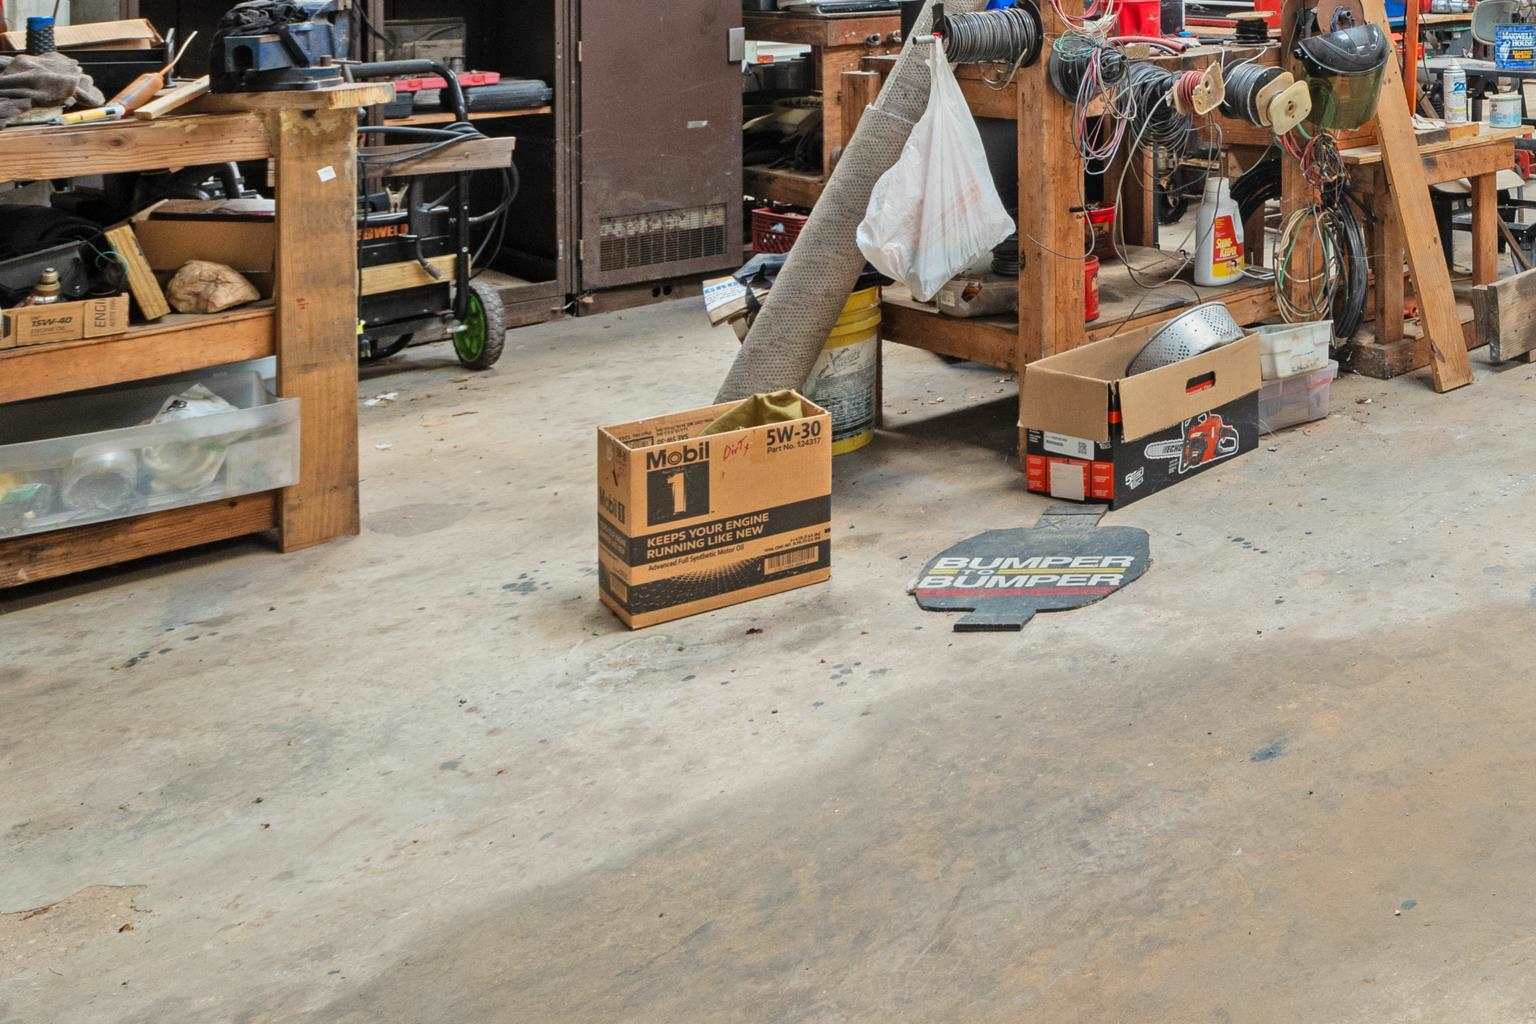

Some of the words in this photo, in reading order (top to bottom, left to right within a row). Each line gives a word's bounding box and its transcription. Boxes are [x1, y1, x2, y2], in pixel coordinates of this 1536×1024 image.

[766, 420, 821, 446] 5W-30
[646, 440, 710, 471] Mobil
[767, 445, 782, 454] Part
[783, 443, 795, 451] No.
[667, 472, 687, 516] 1
[646, 539, 705, 559] RUNNING
[708, 532, 734, 546] LIKE
[736, 525, 764, 539] NEW
[647, 531, 686, 548] KEEPS
[689, 523, 723, 538] YOUR
[725, 513, 770, 530] ENGINE
[648, 559, 678, 571] Advanced
[717, 547, 734, 556] Motor
[934, 555, 1136, 570] BUMPER
[917, 573, 1124, 588] BUMPER
